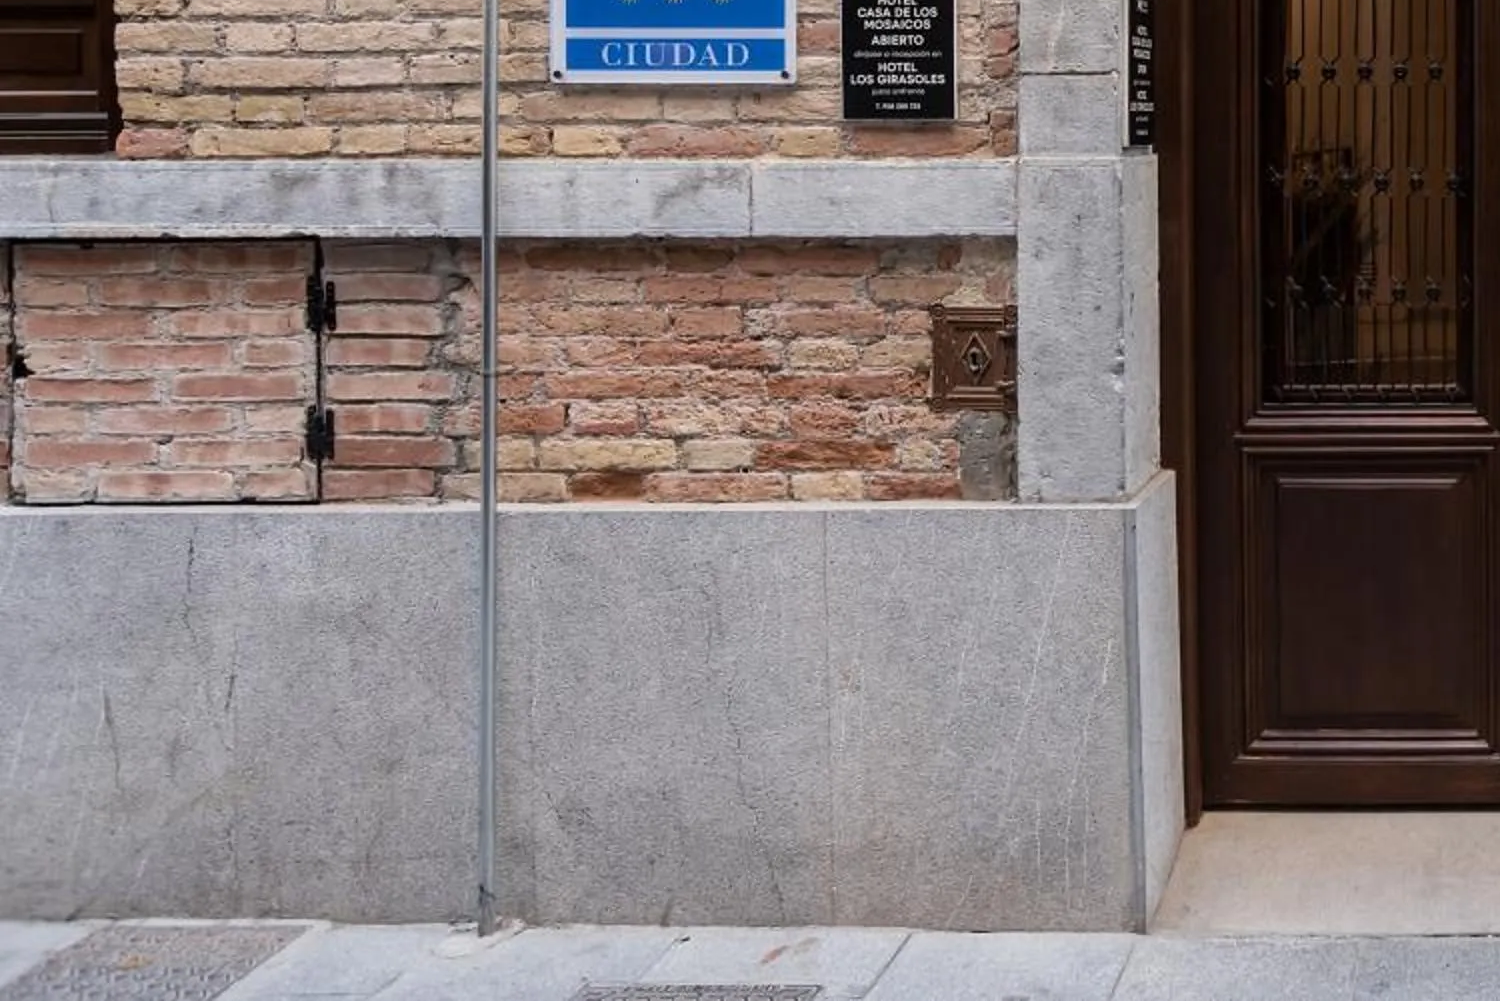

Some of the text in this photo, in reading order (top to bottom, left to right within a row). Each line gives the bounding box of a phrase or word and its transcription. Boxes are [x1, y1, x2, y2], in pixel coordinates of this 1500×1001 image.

[857, 7, 938, 18] CASA DE LOS
[863, 19, 932, 30] MOSAICOS
[871, 35, 925, 46] ABIERTO
[601, 42, 749, 66] CIUDAD
[877, 62, 918, 72] HOTEL
[850, 74, 946, 85] LOS GIRASOLES
